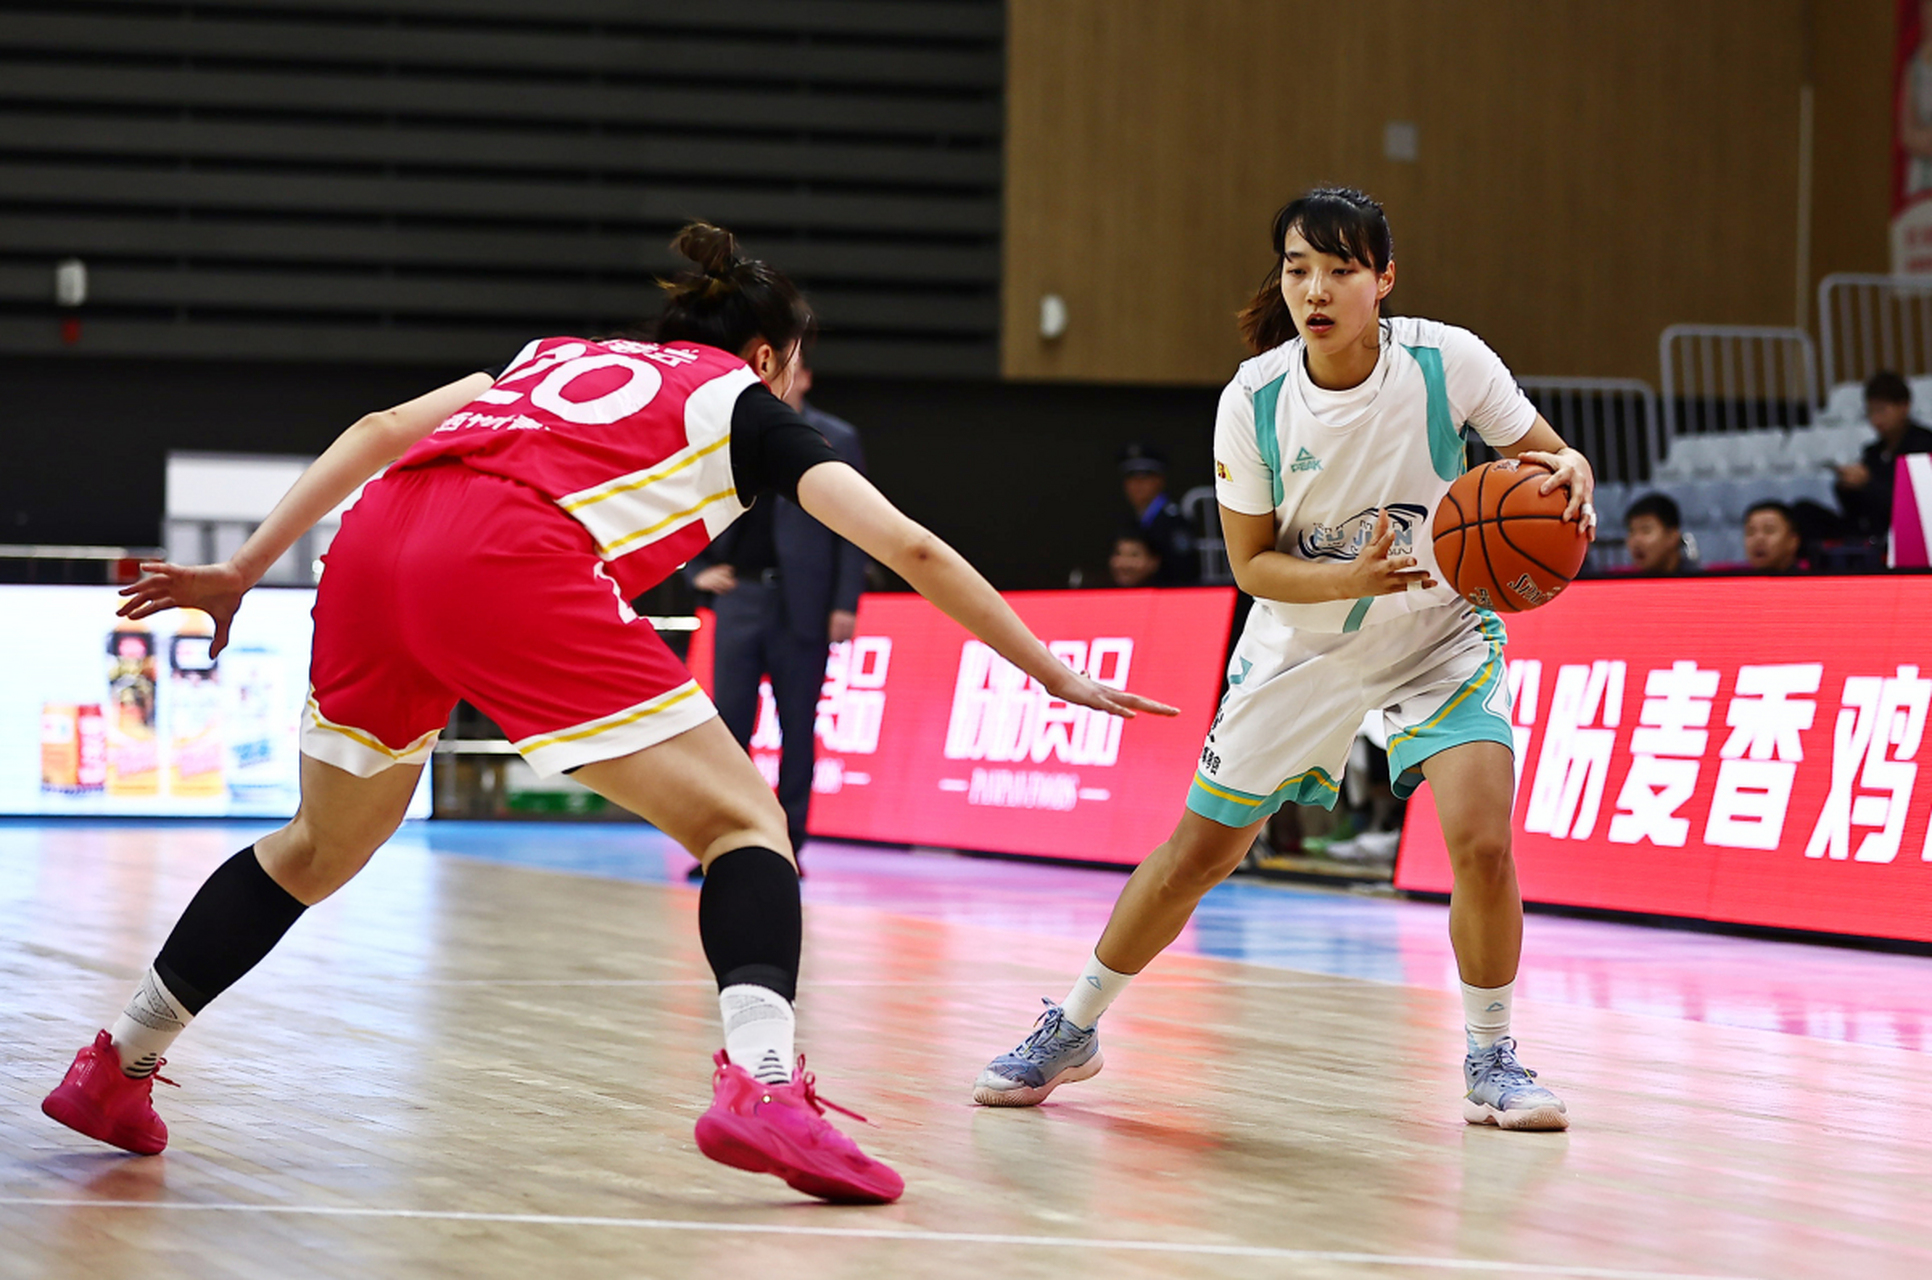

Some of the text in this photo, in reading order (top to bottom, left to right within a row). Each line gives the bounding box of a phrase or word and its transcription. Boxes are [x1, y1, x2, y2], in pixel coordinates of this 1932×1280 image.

[1290, 460, 1323, 473] PEAK
[1352, 524, 1413, 550] JIN
[1508, 660, 1932, 864] 盼麦香鸡
